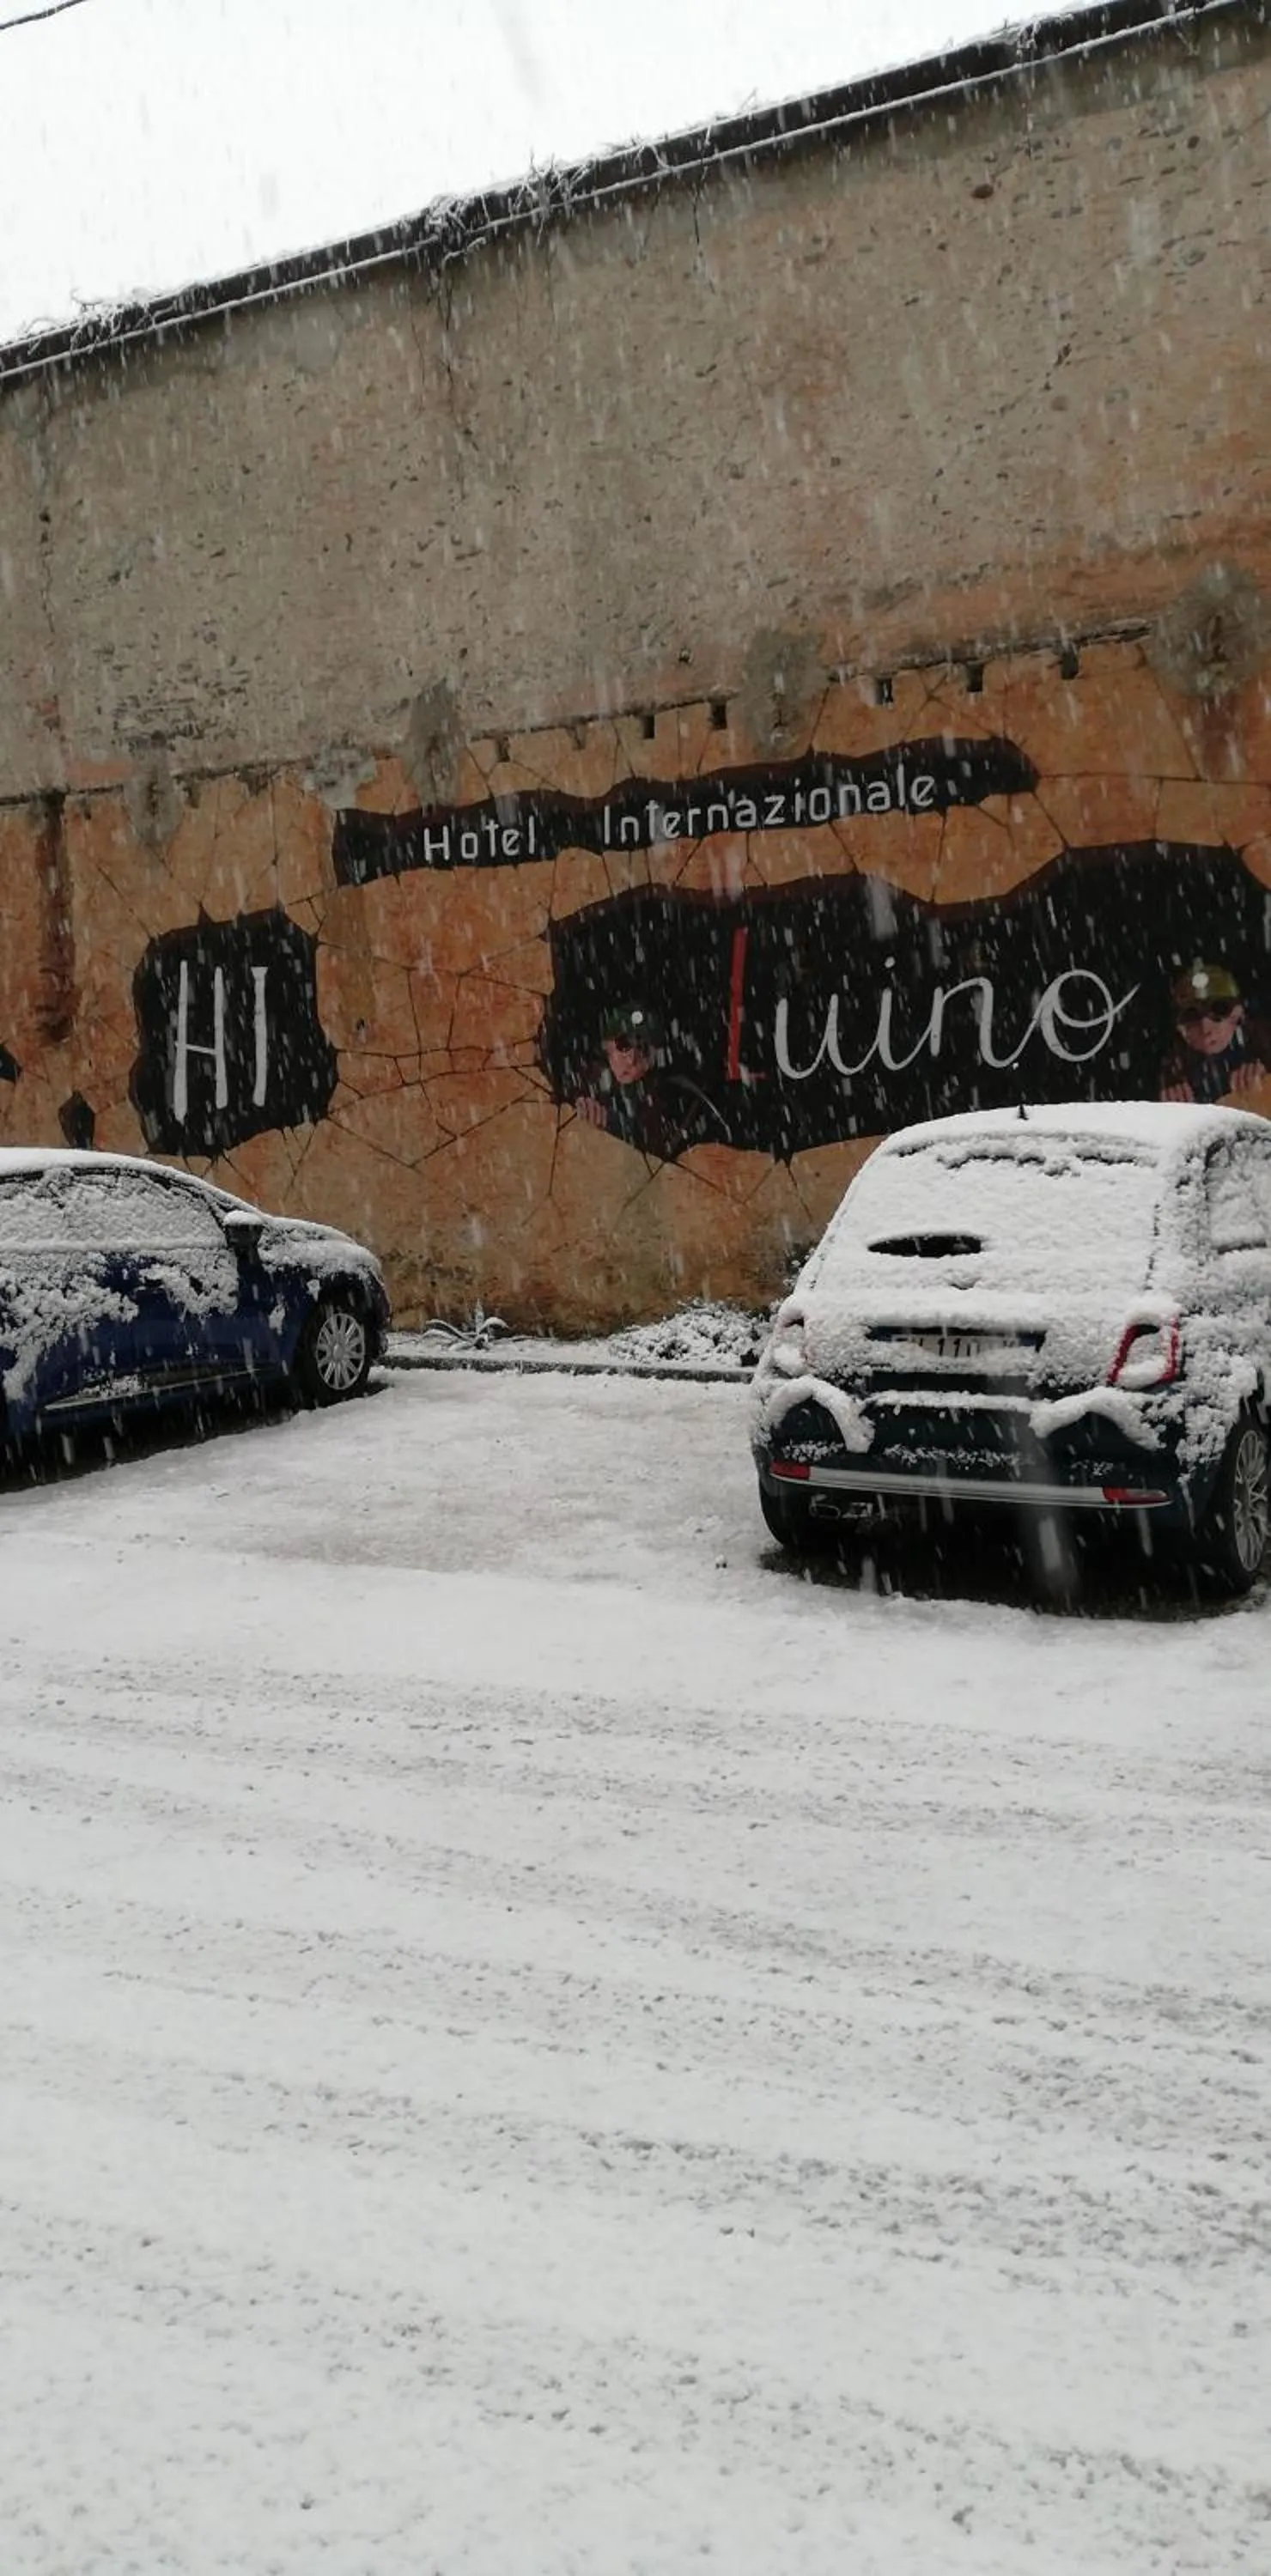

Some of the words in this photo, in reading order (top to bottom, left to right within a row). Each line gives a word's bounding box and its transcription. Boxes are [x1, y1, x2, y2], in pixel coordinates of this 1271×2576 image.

[423, 815, 536, 861] Hotel
[603, 763, 935, 844] Internazionale
[173, 960, 268, 1126] HI
[727, 927, 1140, 1080] Luino
